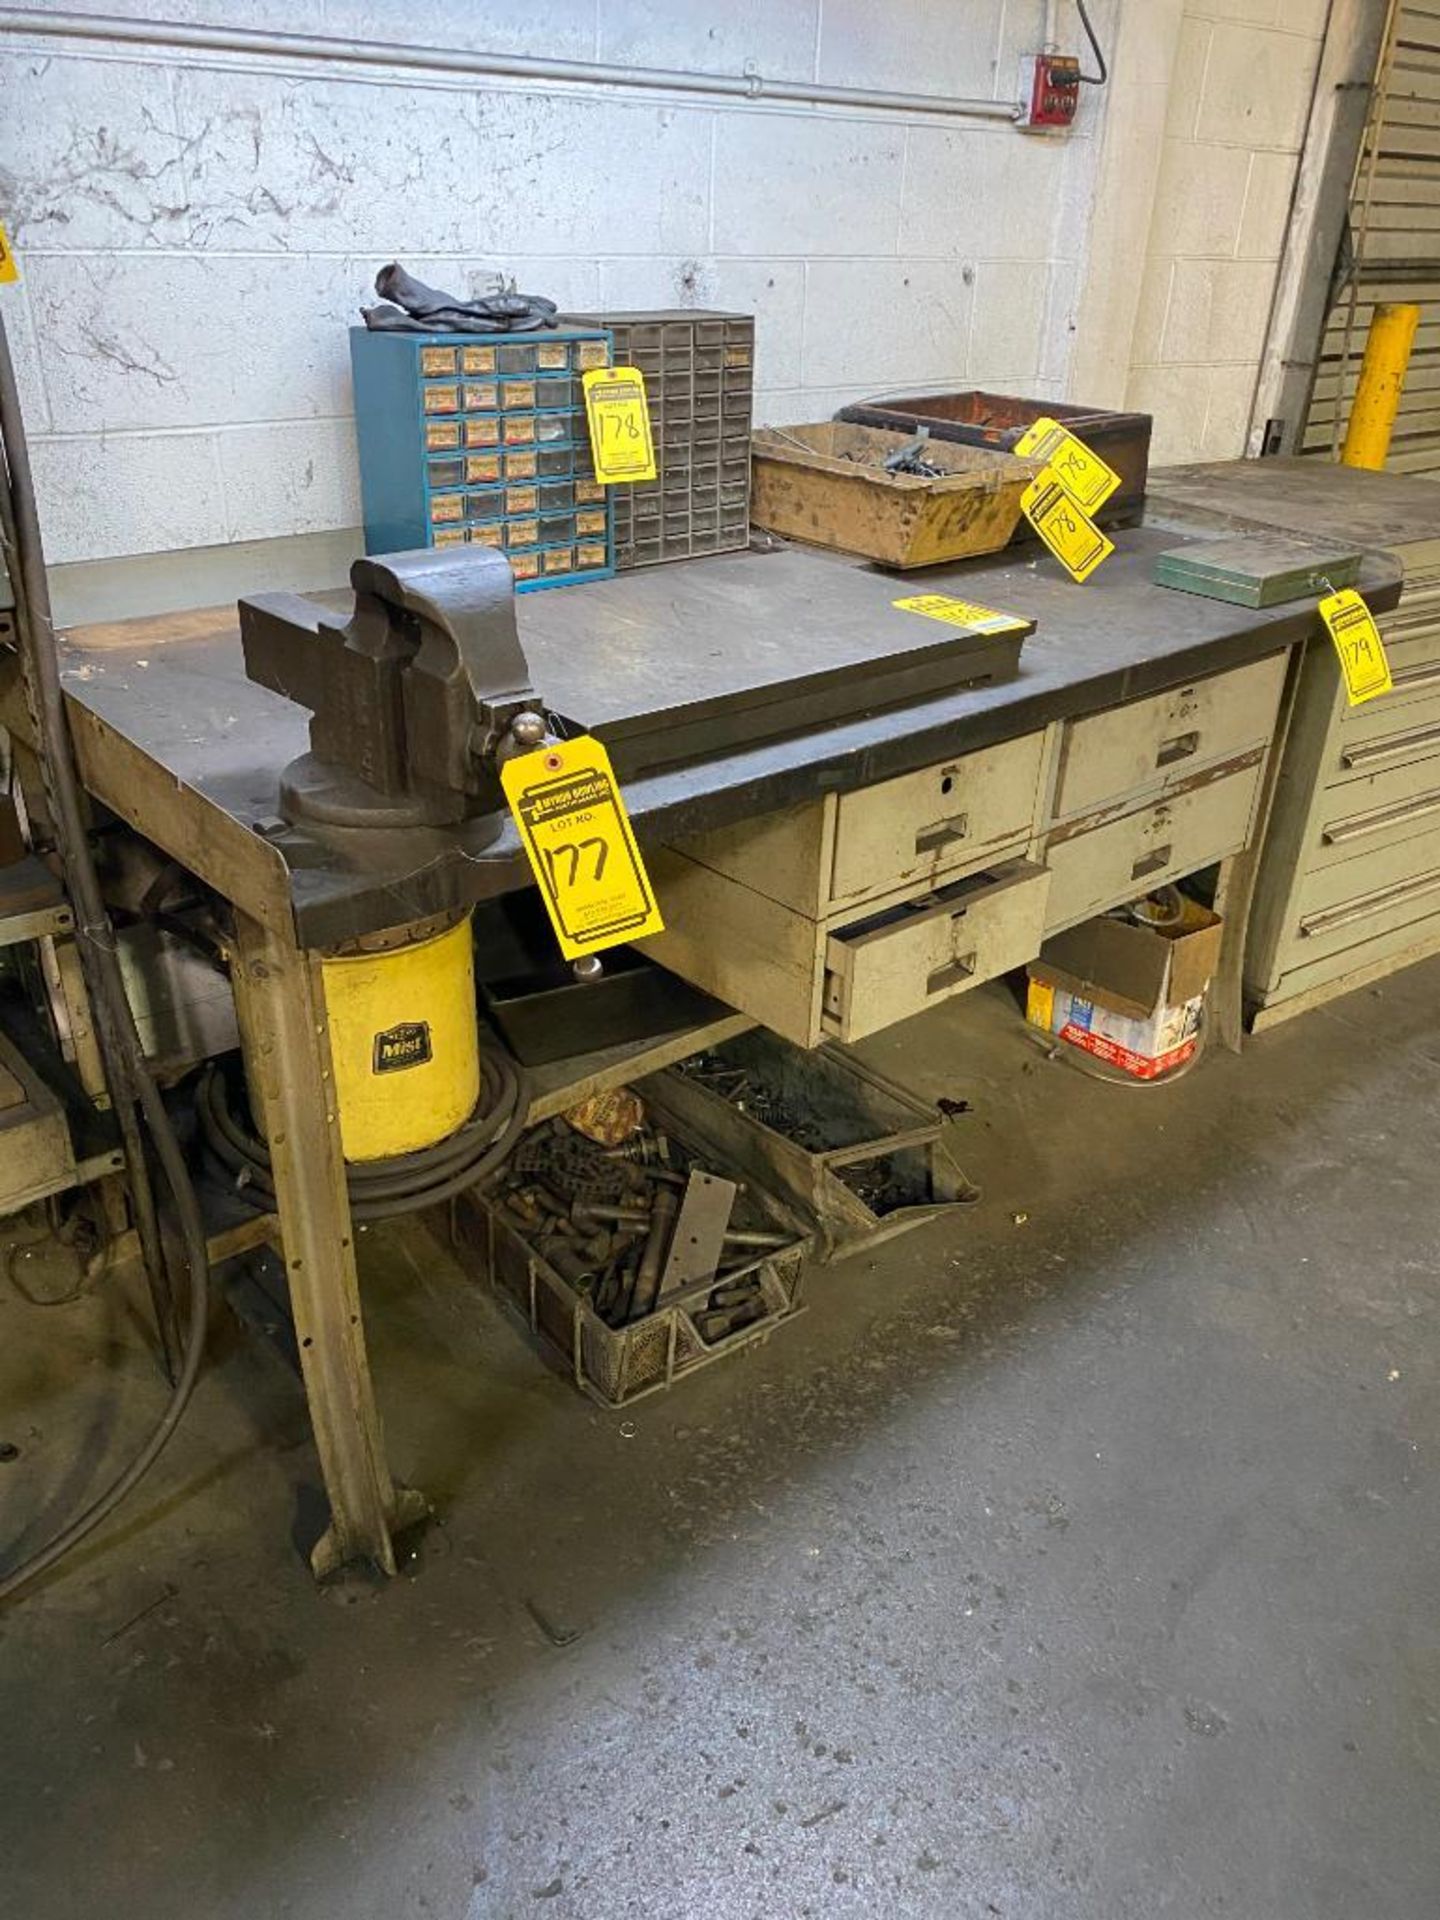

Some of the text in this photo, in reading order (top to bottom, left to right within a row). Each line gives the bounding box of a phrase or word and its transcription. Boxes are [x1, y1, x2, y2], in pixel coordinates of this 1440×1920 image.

[598, 413, 640, 446] 178
[1046, 508, 1076, 548] 178
[1343, 638, 1374, 669] 179
[549, 812, 597, 833] LOT NO.
[543, 837, 610, 900] 177
[381, 1037, 421, 1059] Mist
